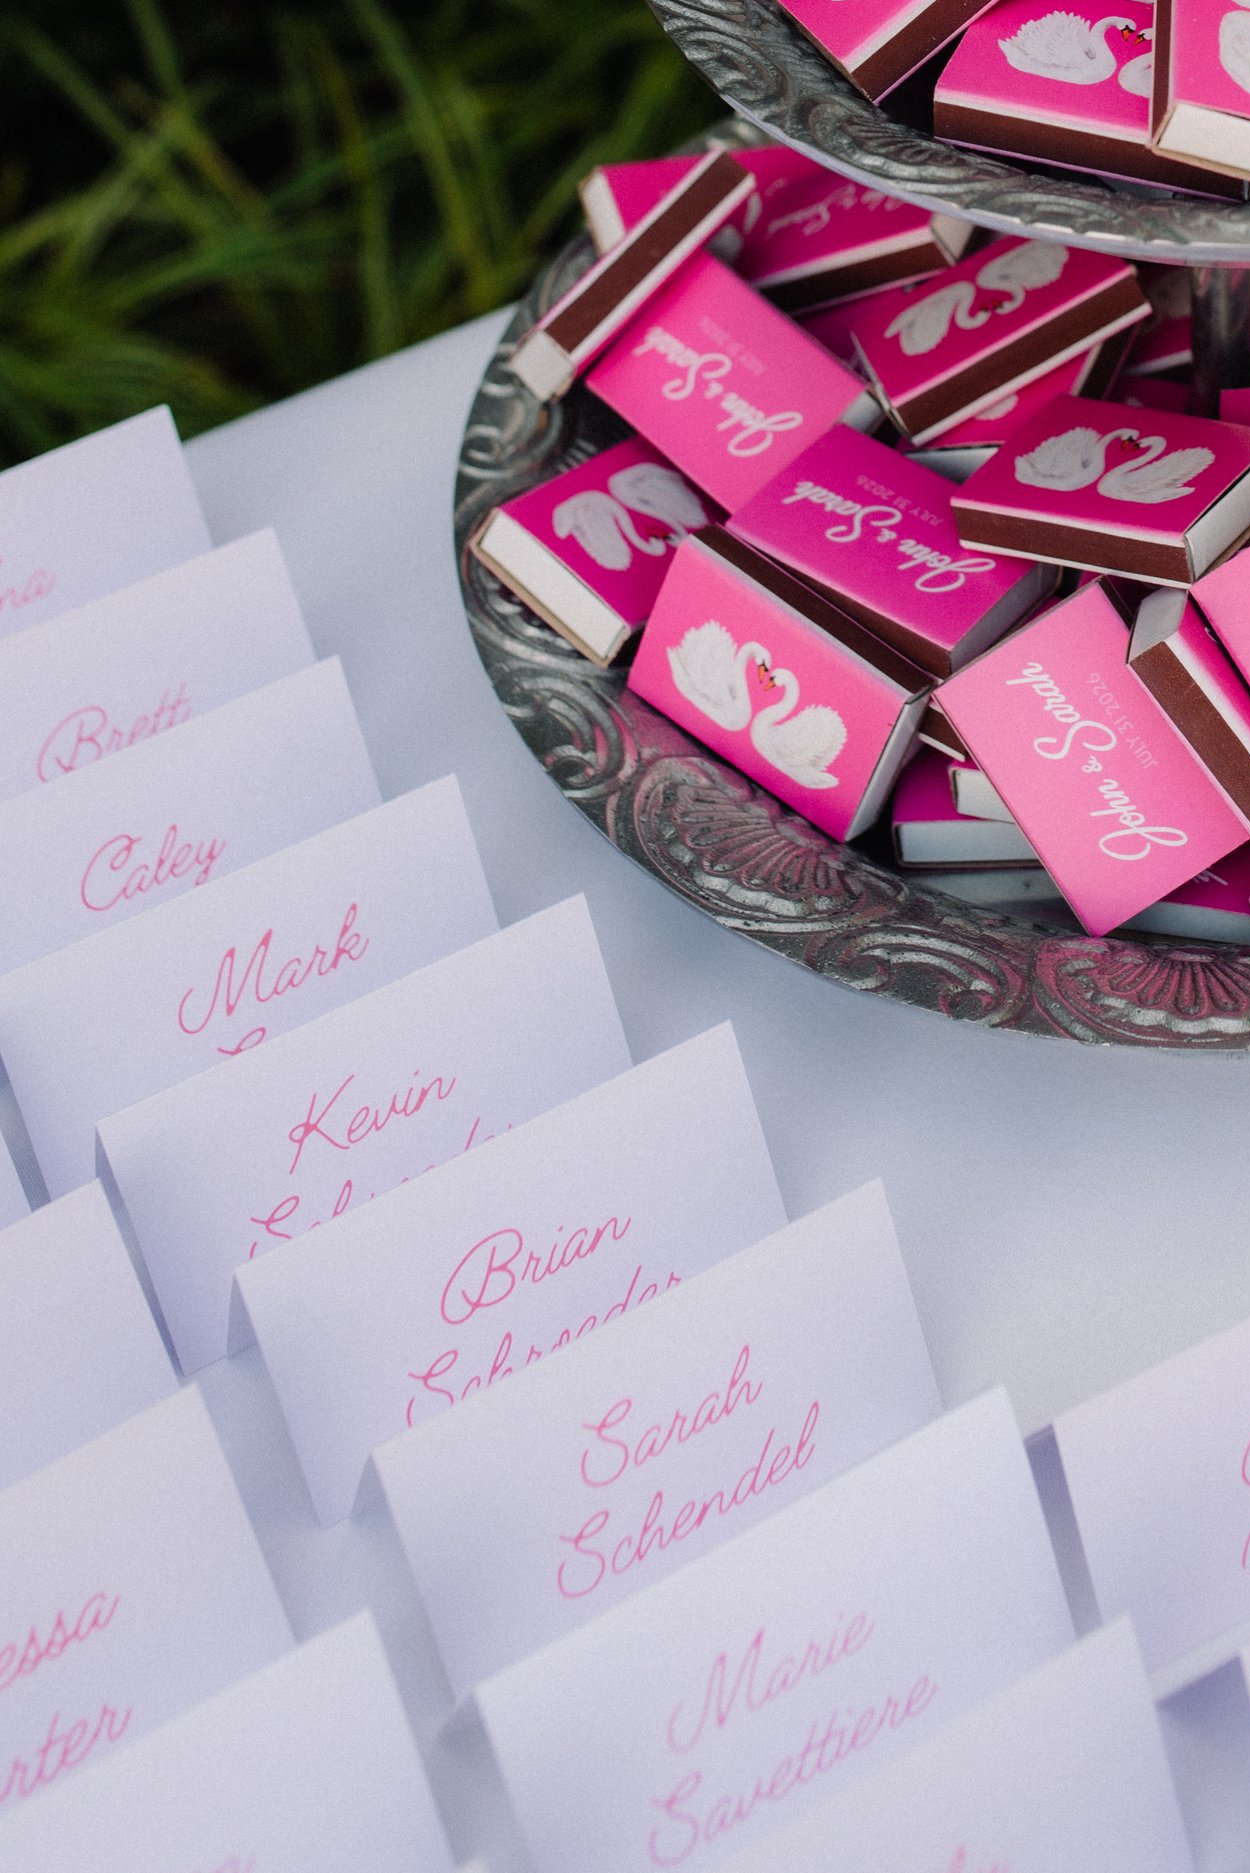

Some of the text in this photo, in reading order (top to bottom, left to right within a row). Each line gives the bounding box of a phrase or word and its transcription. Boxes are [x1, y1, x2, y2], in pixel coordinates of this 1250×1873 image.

[632, 326, 733, 401] Sarah
[716, 391, 804, 457] John
[782, 481, 997, 594] John & Sarah
[36, 679, 193, 783] Brett
[1087, 672, 1122, 717] 2026
[1005, 661, 1189, 861] John & Sarah
[1125, 735, 1159, 770] JULY
[81, 824, 228, 912] Caley
[178, 902, 370, 1035] Mark
[288, 1070, 457, 1175] Kevin
[440, 1215, 632, 1325] Brian
[581, 1343, 763, 1489] Sarah
[557, 1399, 820, 1600] Schendel
[664, 1610, 878, 1756] Marie
